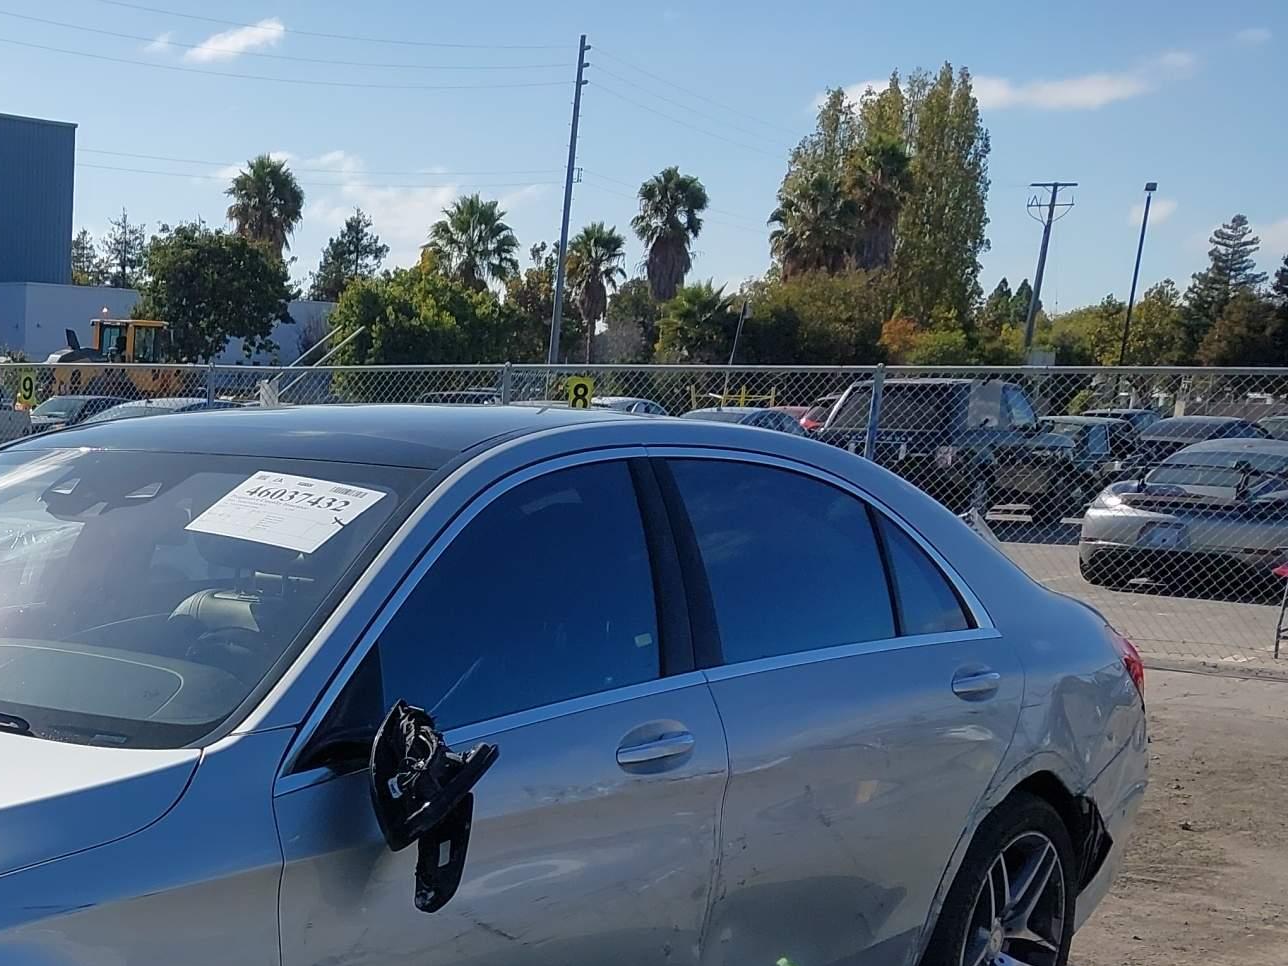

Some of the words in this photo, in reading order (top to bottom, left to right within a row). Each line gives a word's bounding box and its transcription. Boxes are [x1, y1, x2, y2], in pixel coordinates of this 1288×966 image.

[22, 376, 34, 400] 9
[572, 383, 589, 408] 8
[246, 485, 351, 512] 46037432
